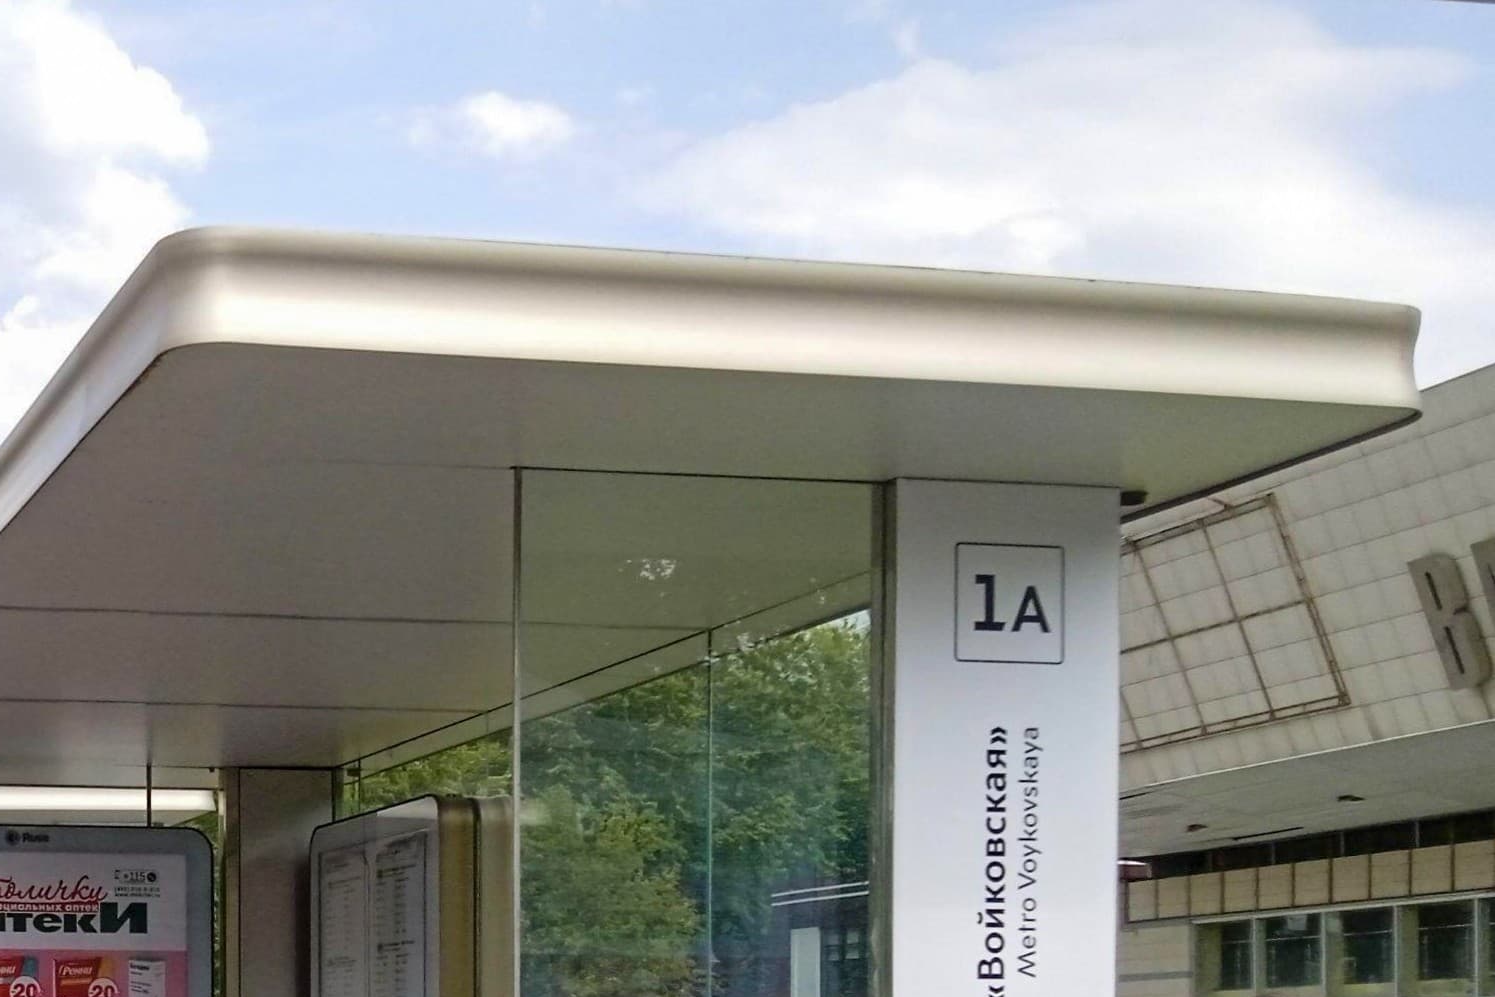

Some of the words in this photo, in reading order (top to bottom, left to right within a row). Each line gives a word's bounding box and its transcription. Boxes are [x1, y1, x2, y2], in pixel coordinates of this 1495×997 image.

[1017, 726, 1040, 890] Voykovskaya
[64, 904, 99, 913] аптек
[1017, 897, 1038, 978] Metro
